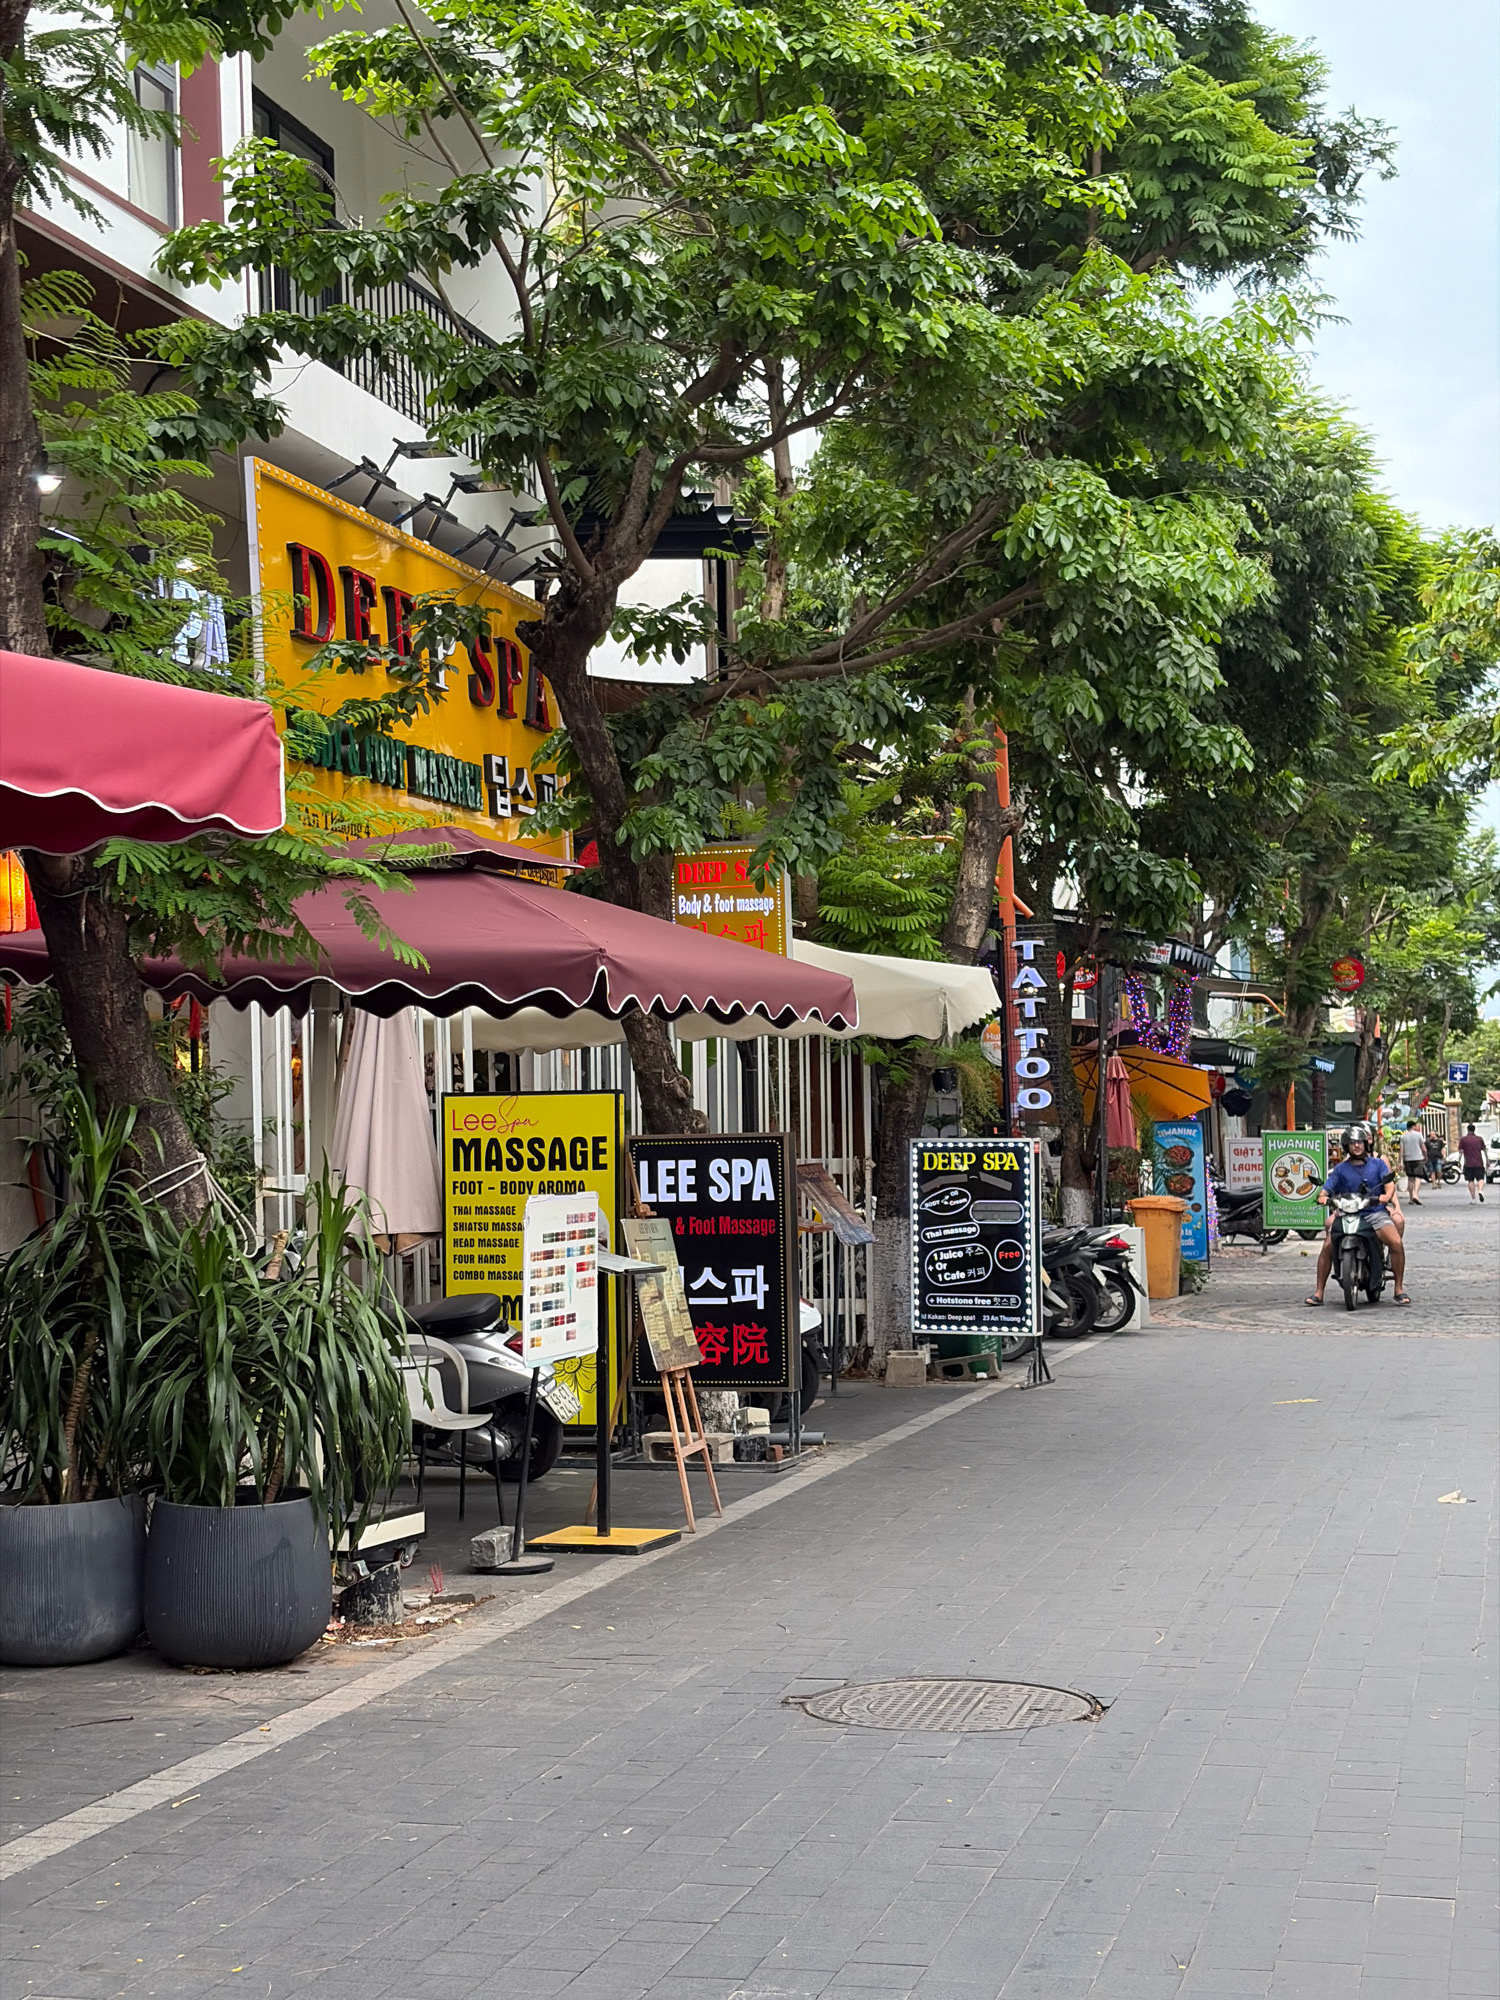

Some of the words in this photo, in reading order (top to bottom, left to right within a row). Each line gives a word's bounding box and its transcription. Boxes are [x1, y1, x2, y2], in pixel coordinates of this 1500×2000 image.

[407, 744, 484, 812] MASSAGE
[677, 860, 728, 885] DEEP
[678, 893, 702, 920] Body
[703, 893, 713, 914] &
[714, 893, 735, 913] foot
[736, 897, 775, 917] massage
[1011, 940, 1052, 1110] TATTOO
[452, 1109, 497, 1132] Lee
[497, 1095, 540, 1134] Spa
[1268, 1139, 1321, 1152] HWANINE
[452, 1135, 609, 1173] MASSAGE
[923, 1152, 976, 1171] DEEP
[982, 1152, 1020, 1171] SPA
[639, 1159, 698, 1203] LEE
[708, 1158, 776, 1203] SPA
[452, 1181, 484, 1196] FOOT
[500, 1180, 534, 1196] BODY
[538, 1180, 586, 1195] AROMA
[453, 1206, 472, 1216] THAI
[475, 1205, 517, 1216] MASSAGE
[924, 1200, 940, 1208] BODY
[453, 1222, 489, 1232] SHIATSU
[676, 1216, 685, 1235] &
[689, 1216, 716, 1236] Foot
[719, 1215, 776, 1237] Massage
[925, 1229, 943, 1239] Thai
[943, 1227, 977, 1236] massage
[453, 1238, 476, 1249] HEAD
[478, 1238, 520, 1248] MASSAGE
[453, 1254, 475, 1265] FOUR
[478, 1254, 507, 1265] HANDS
[933, 1252, 938, 1261] 1
[939, 1250, 964, 1261] Juice
[965, 1246, 984, 1257] 주스
[998, 1250, 1020, 1260] Free
[935, 1261, 948, 1271] Or
[453, 1270, 485, 1281] COMBO
[938, 1273, 943, 1281] 1
[944, 1271, 966, 1281] Cafe
[967, 1266, 986, 1278] 커피
[936, 1297, 973, 1305] Hotstone
[974, 1297, 992, 1305] free
[947, 1314, 962, 1322] Deep
